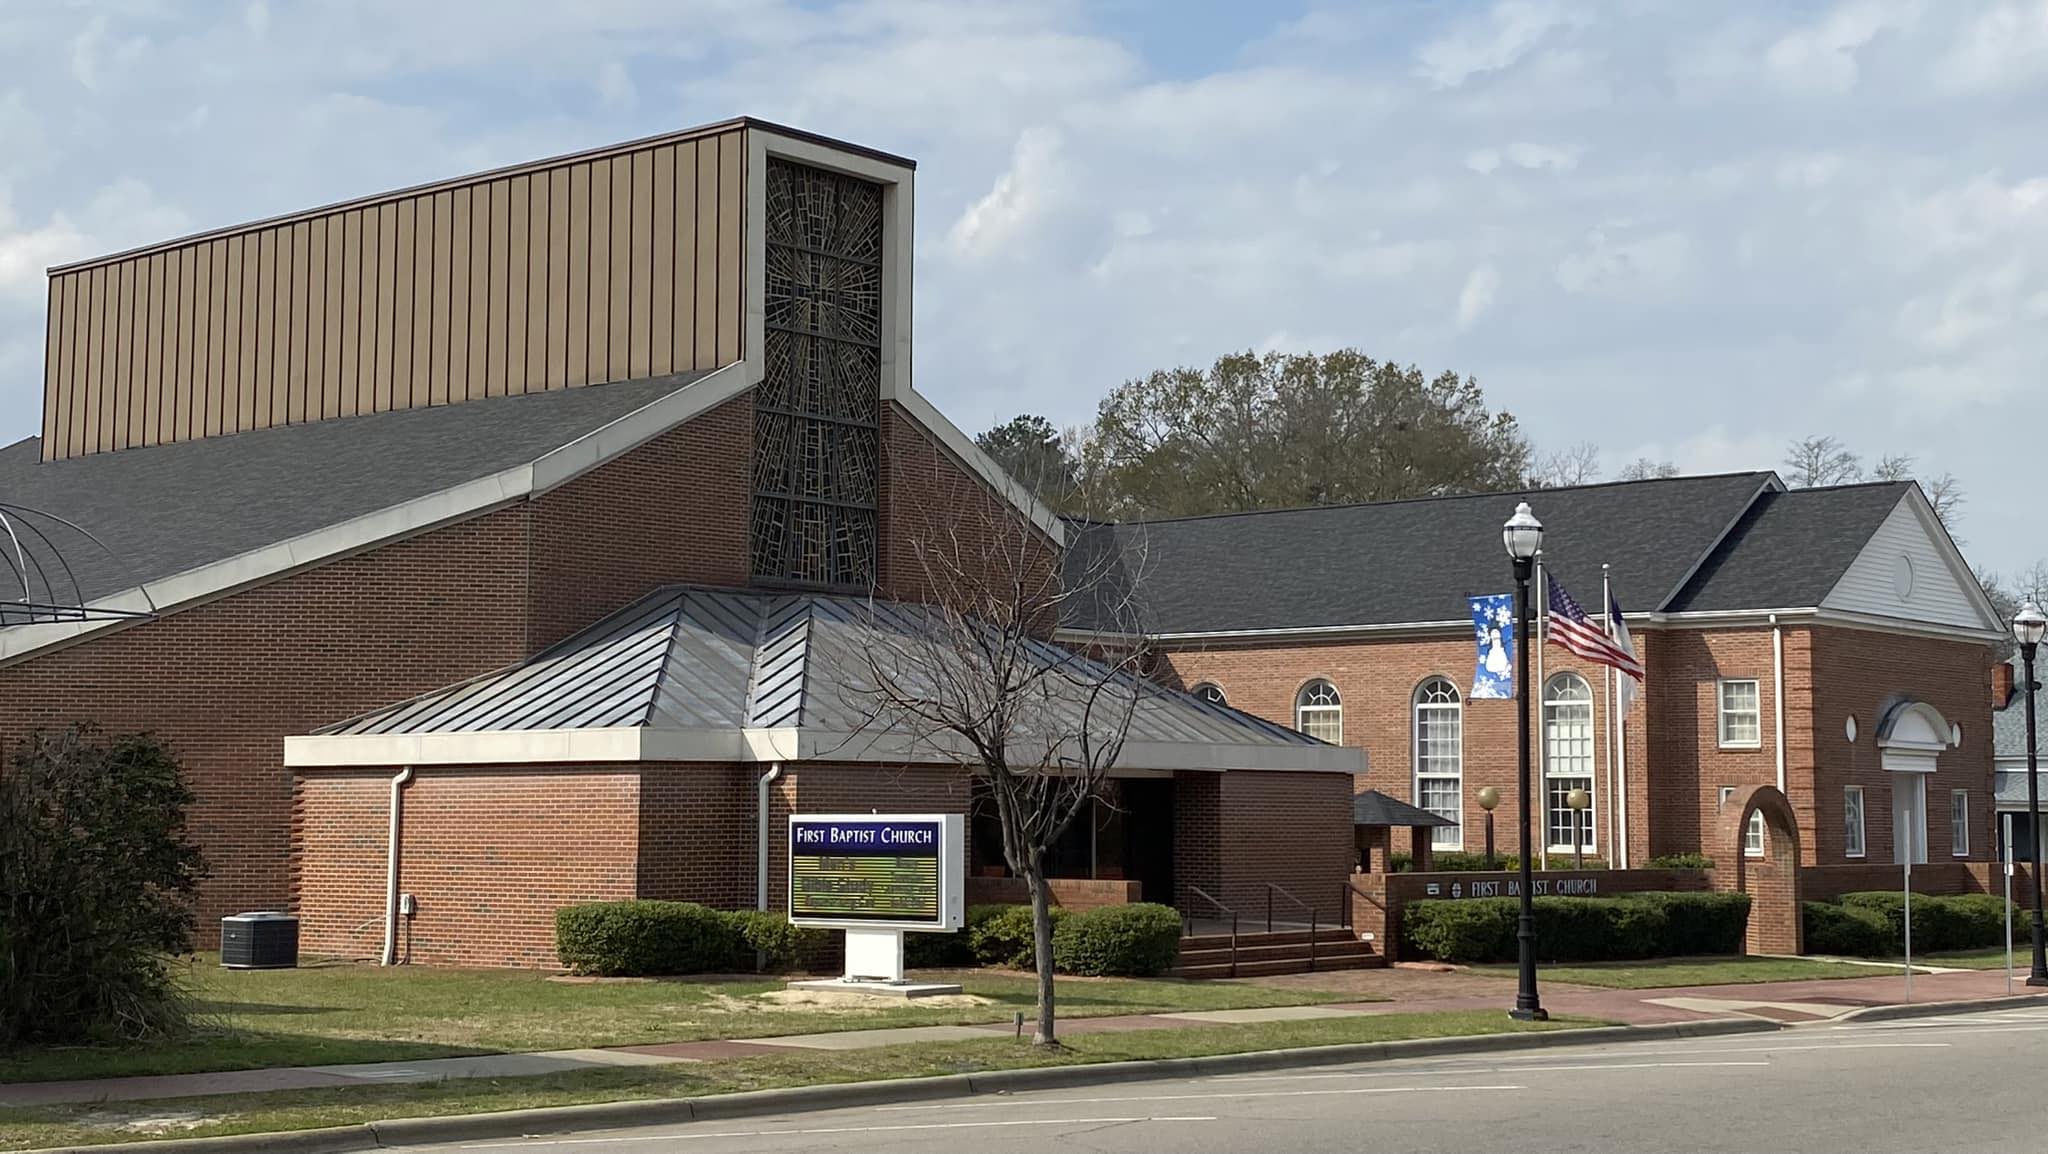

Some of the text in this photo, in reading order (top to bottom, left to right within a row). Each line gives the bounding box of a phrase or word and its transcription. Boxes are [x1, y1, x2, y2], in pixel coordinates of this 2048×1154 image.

[796, 827, 933, 844] FIRST BAPTIST CHURCH
[1472, 879, 1597, 897] FIRST BAIST CHURCH
